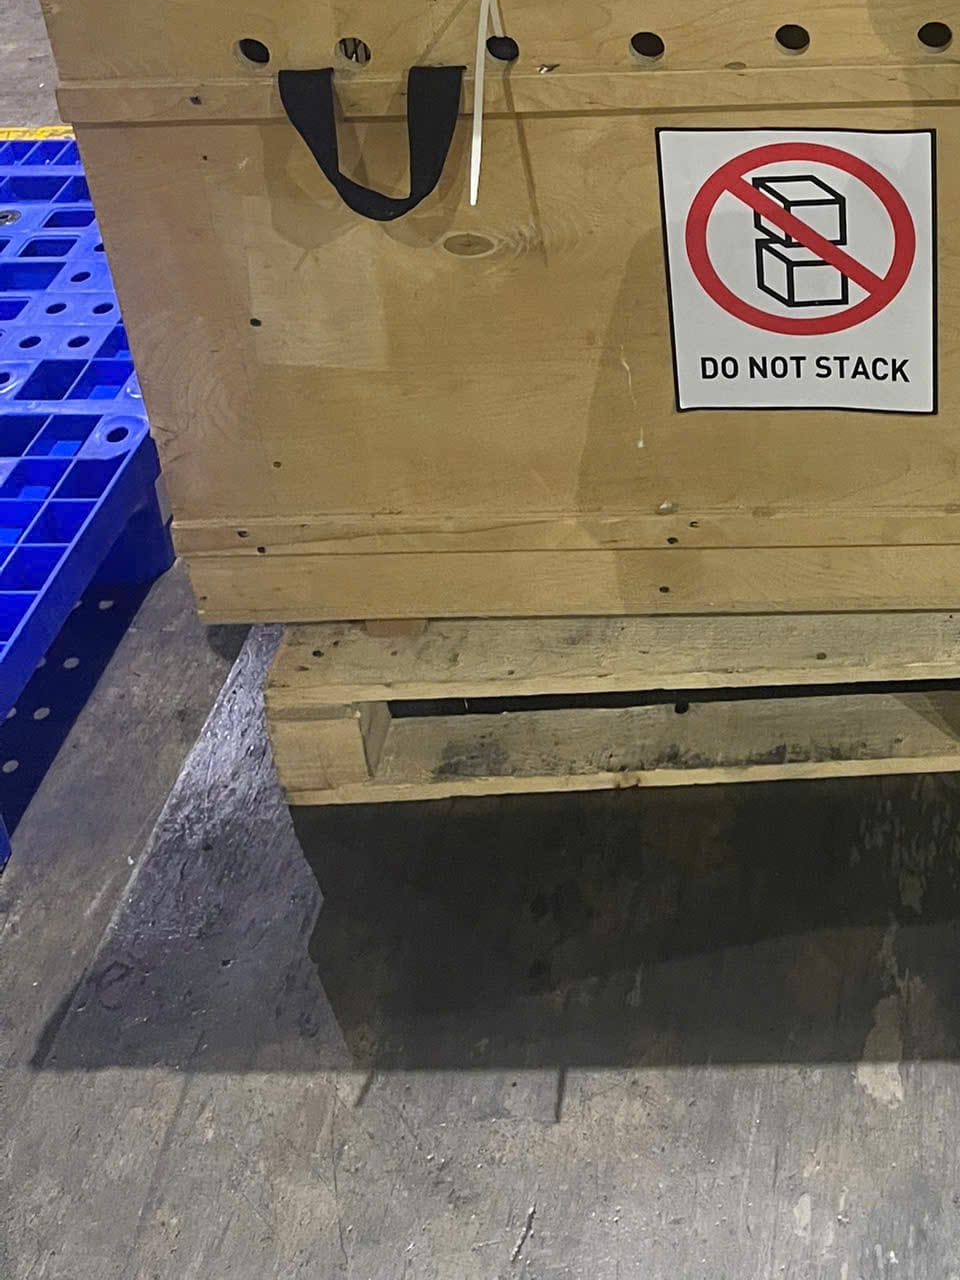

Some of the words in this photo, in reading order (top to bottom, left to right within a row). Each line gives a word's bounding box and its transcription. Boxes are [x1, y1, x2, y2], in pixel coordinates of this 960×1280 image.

[700, 356, 739, 380] DO
[749, 356, 807, 379] NOT
[815, 356, 910, 382] STACK
